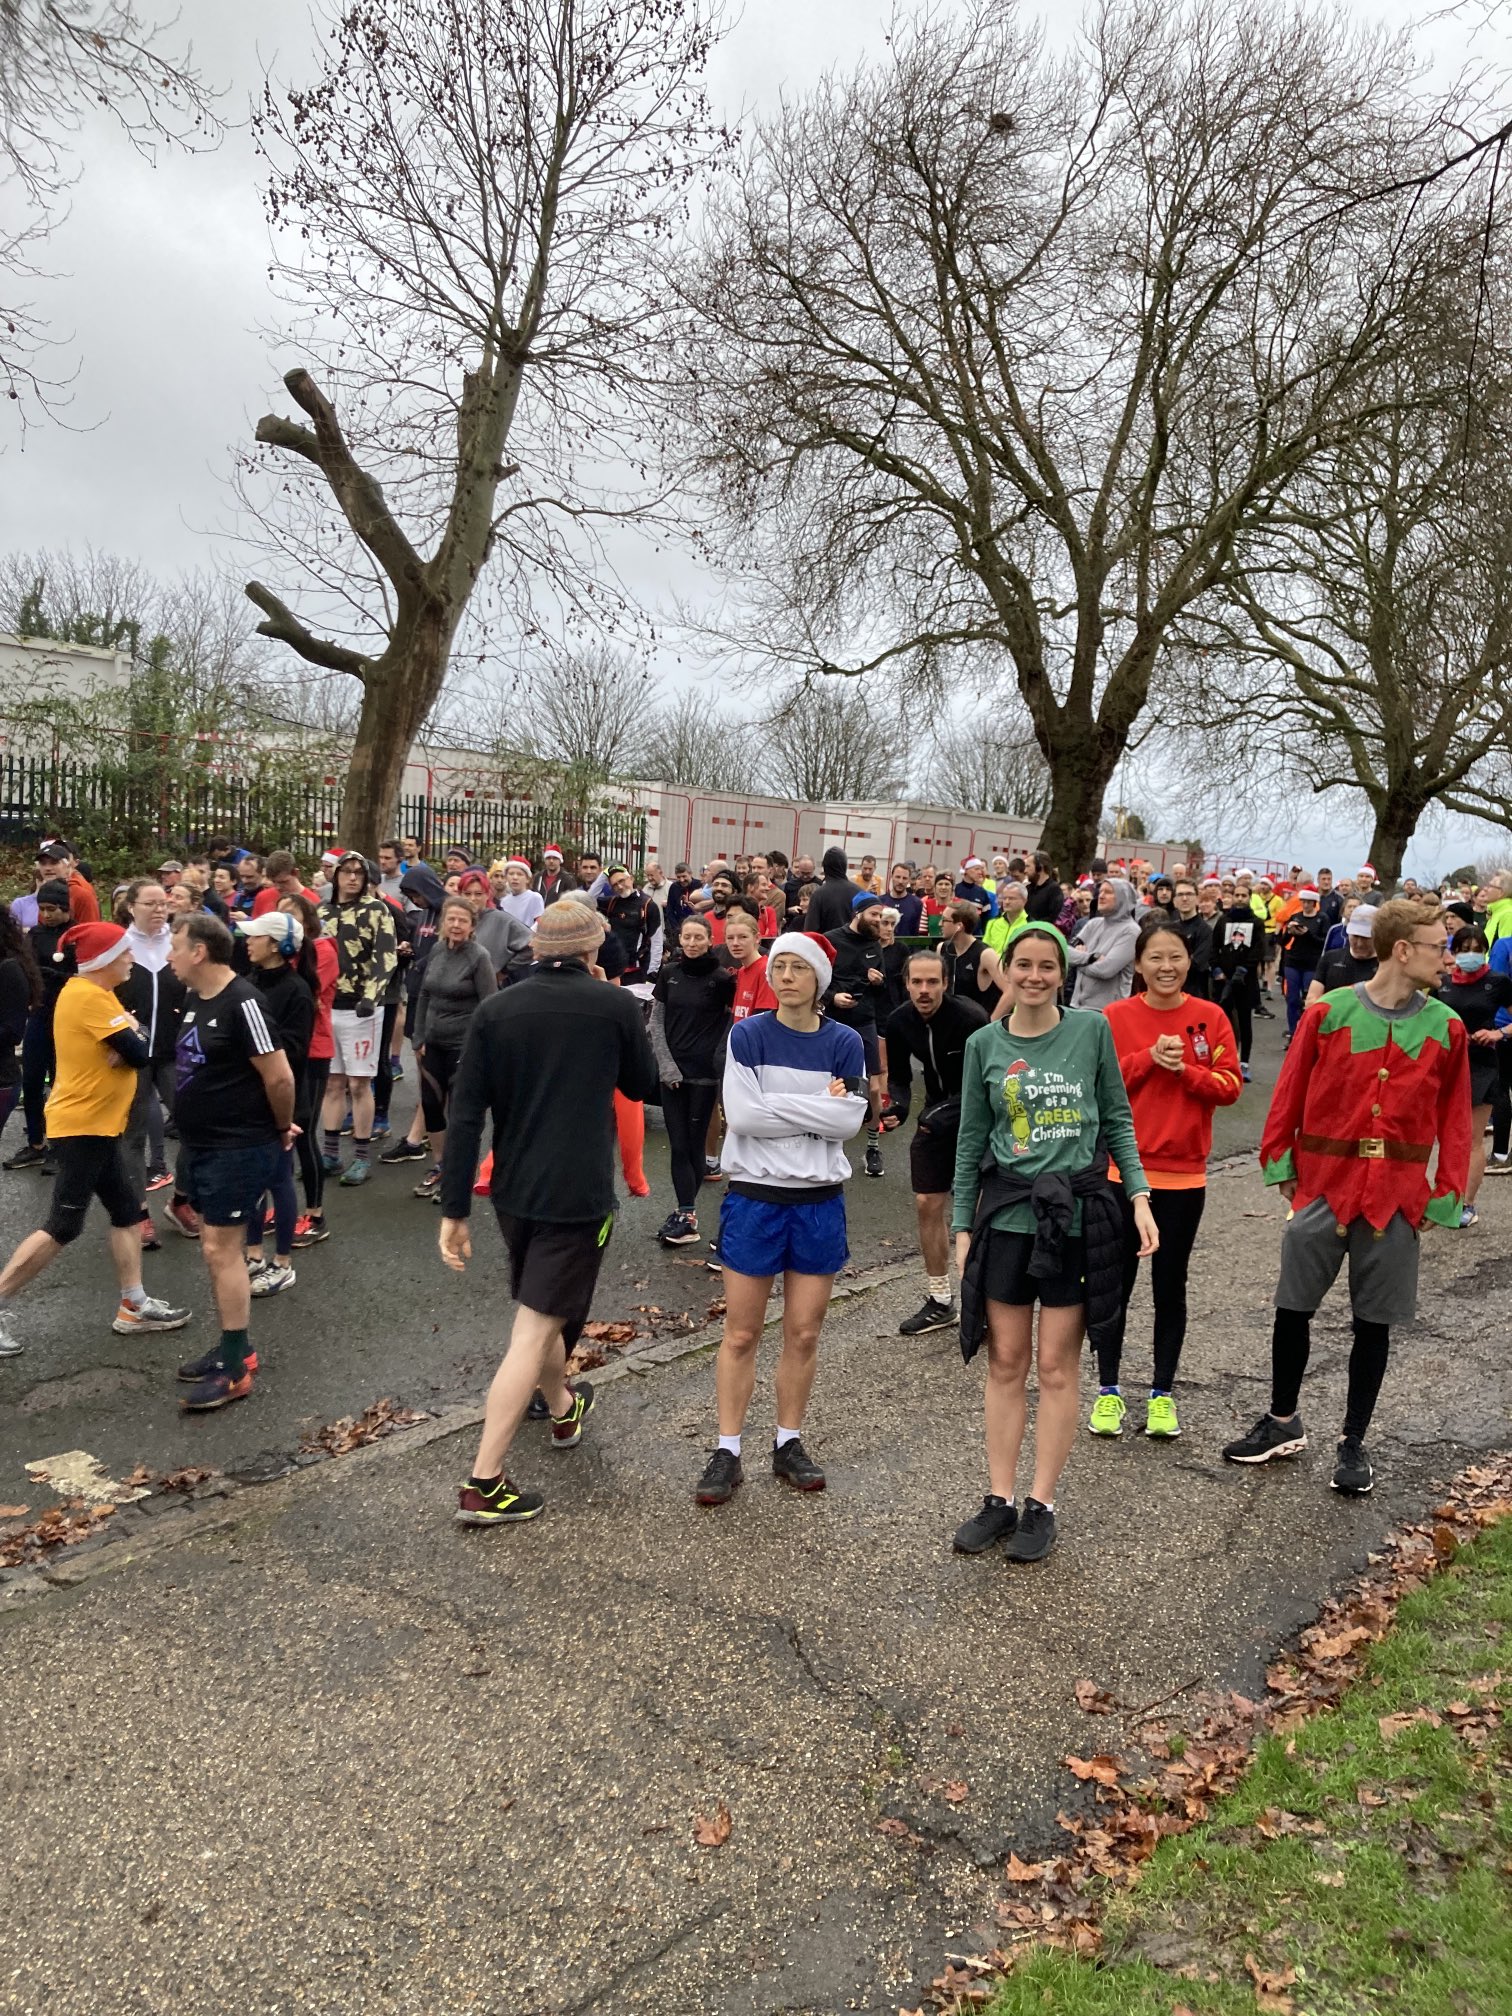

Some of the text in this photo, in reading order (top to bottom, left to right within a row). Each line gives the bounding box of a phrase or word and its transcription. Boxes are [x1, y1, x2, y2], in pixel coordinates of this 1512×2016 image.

[355, 1040, 370, 1058] 17
[1043, 1072, 1064, 1084] I'm
[1025, 1082, 1082, 1100] Dreaming
[1045, 1096, 1068, 1107] of a
[1034, 1108, 1081, 1124] GREEN
[1032, 1126, 1081, 1142] Christma
